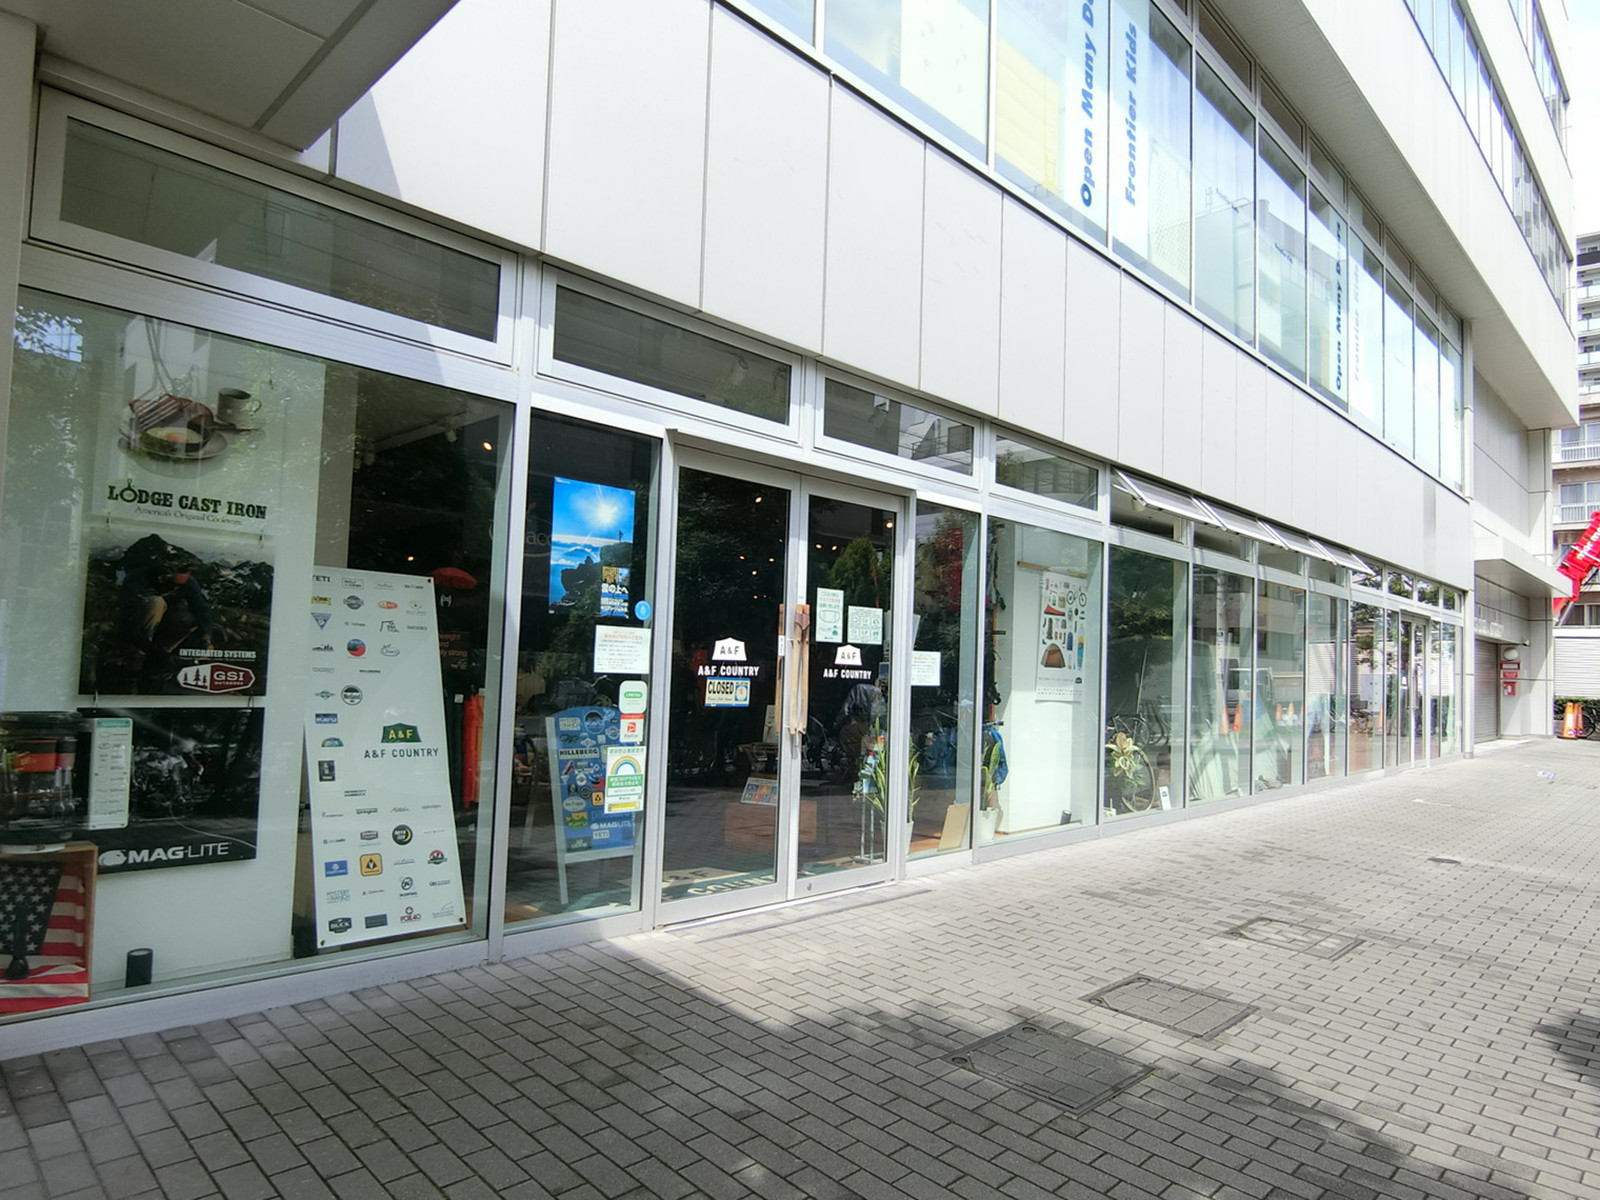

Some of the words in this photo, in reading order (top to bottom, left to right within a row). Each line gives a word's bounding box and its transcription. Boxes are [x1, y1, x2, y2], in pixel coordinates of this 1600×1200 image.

[1082, 0, 1095, 28] D
[1125, 22, 1137, 85] Kids
[1081, 31, 1097, 119] Many
[1125, 89, 1137, 206] Frontier
[1080, 127, 1095, 208] Open
[1335, 281, 1343, 334] Many
[1335, 340, 1343, 391] Open
[107, 479, 173, 508] LODGE
[178, 495, 221, 514] CAST
[226, 501, 268, 519] IRON
[179, 648, 223, 658] INTEGRATED
[223, 649, 257, 659] SYSTEMS
[719, 645, 740, 655] A&F
[840, 651, 857, 660] A&F
[213, 671, 245, 681] GSI
[697, 665, 717, 676] A&F
[720, 665, 760, 677] COUNTRY
[823, 668, 839, 679] A&F
[840, 669, 872, 680] COUNTRY
[707, 681, 735, 695] CLOSED
[387, 729, 413, 740] A&F
[364, 749, 387, 759] A&F
[391, 747, 440, 758] COUNTRY
